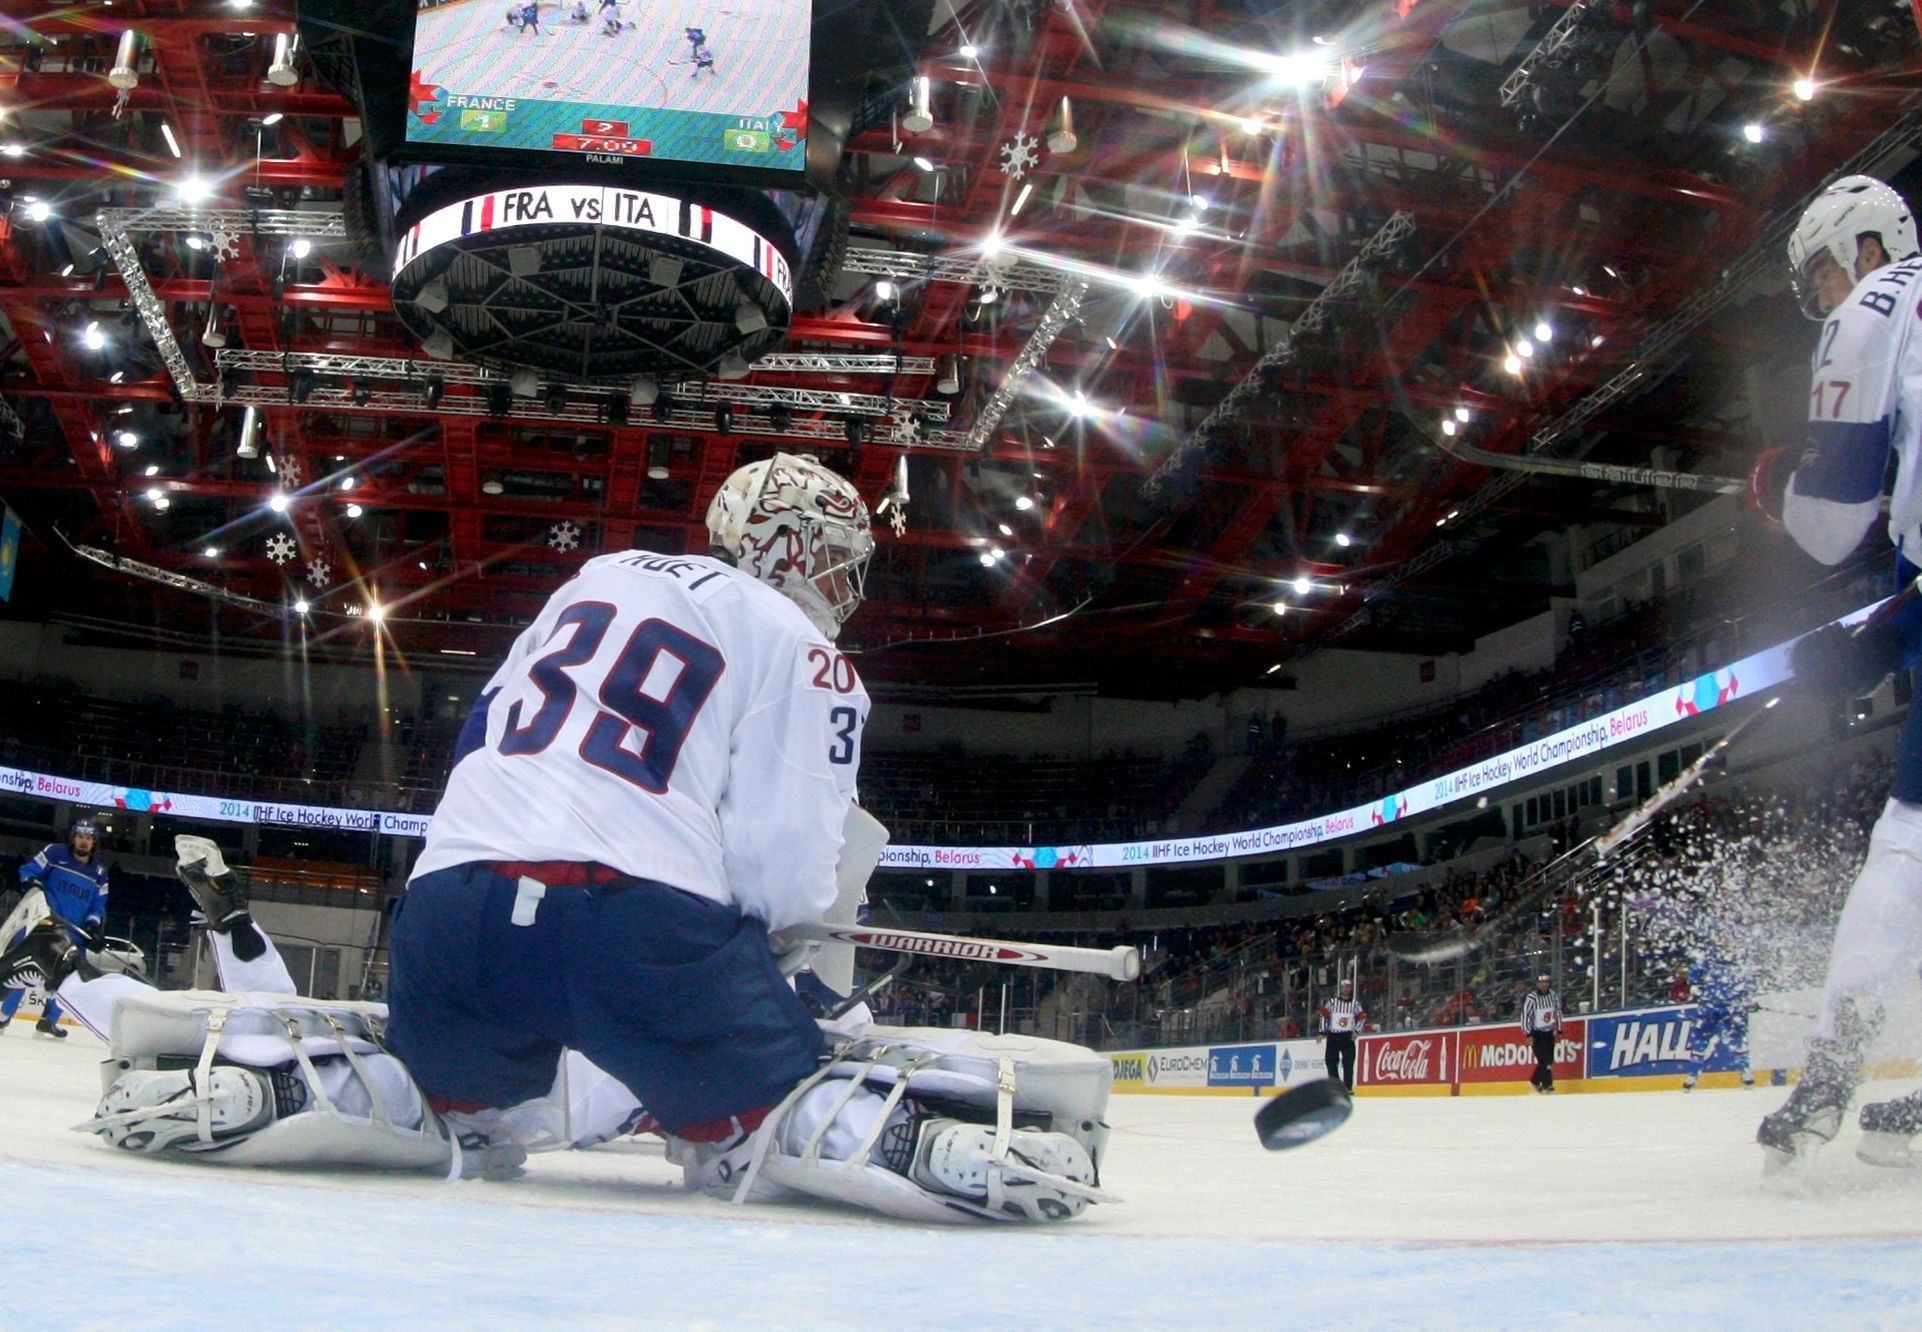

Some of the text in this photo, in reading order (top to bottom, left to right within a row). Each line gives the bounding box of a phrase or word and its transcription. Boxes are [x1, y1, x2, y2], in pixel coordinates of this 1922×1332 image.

[447, 96, 516, 111] FRANCE
[503, 191, 553, 223] FRA
[614, 192, 656, 227] ITA
[1813, 381, 1851, 418] 17
[808, 649, 855, 694] 20
[498, 600, 725, 795] 39
[829, 706, 864, 764] 3
[1482, 760, 1512, 783] Hockey
[1513, 745, 1538, 771] World
[1610, 711, 1648, 737] Belarus
[0, 772, 80, 797] nship, Belarus
[219, 801, 249, 817] 2014
[277, 807, 294, 823] Ice
[297, 808, 341, 828] Hockey
[346, 813, 380, 831] Worl
[385, 815, 431, 836] Champ
[1122, 846, 1149, 861] 2014
[1173, 843, 1191, 857] Ice
[1193, 838, 1230, 858] Hockey
[1232, 832, 1260, 850] World
[1325, 816, 1354, 834] Belarus
[935, 850, 980, 864] Belarus
[870, 934, 999, 959] WARRIOR
[1480, 1039, 1577, 1067] McDond's
